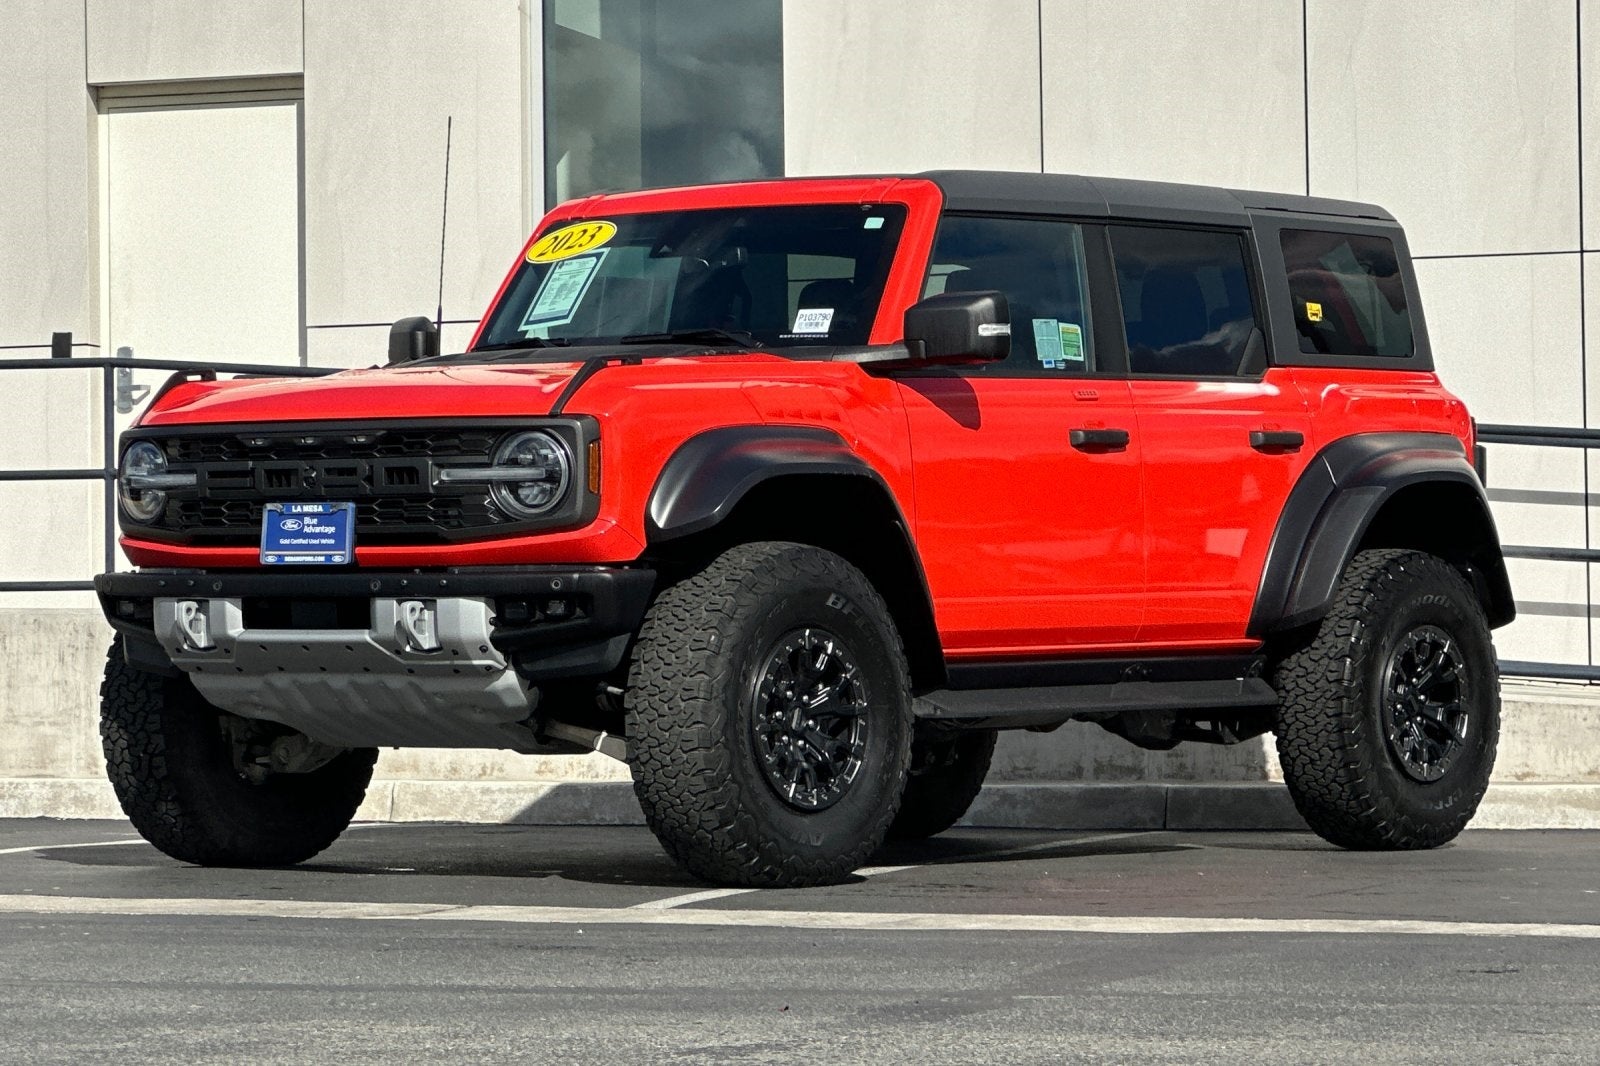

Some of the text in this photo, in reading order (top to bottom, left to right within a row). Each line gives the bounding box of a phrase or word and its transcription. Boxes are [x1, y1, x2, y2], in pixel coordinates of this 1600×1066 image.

[535, 225, 603, 258] 2023
[798, 313, 832, 321] P103790
[303, 516, 318, 524] Blue
[303, 525, 336, 534] Advantage
